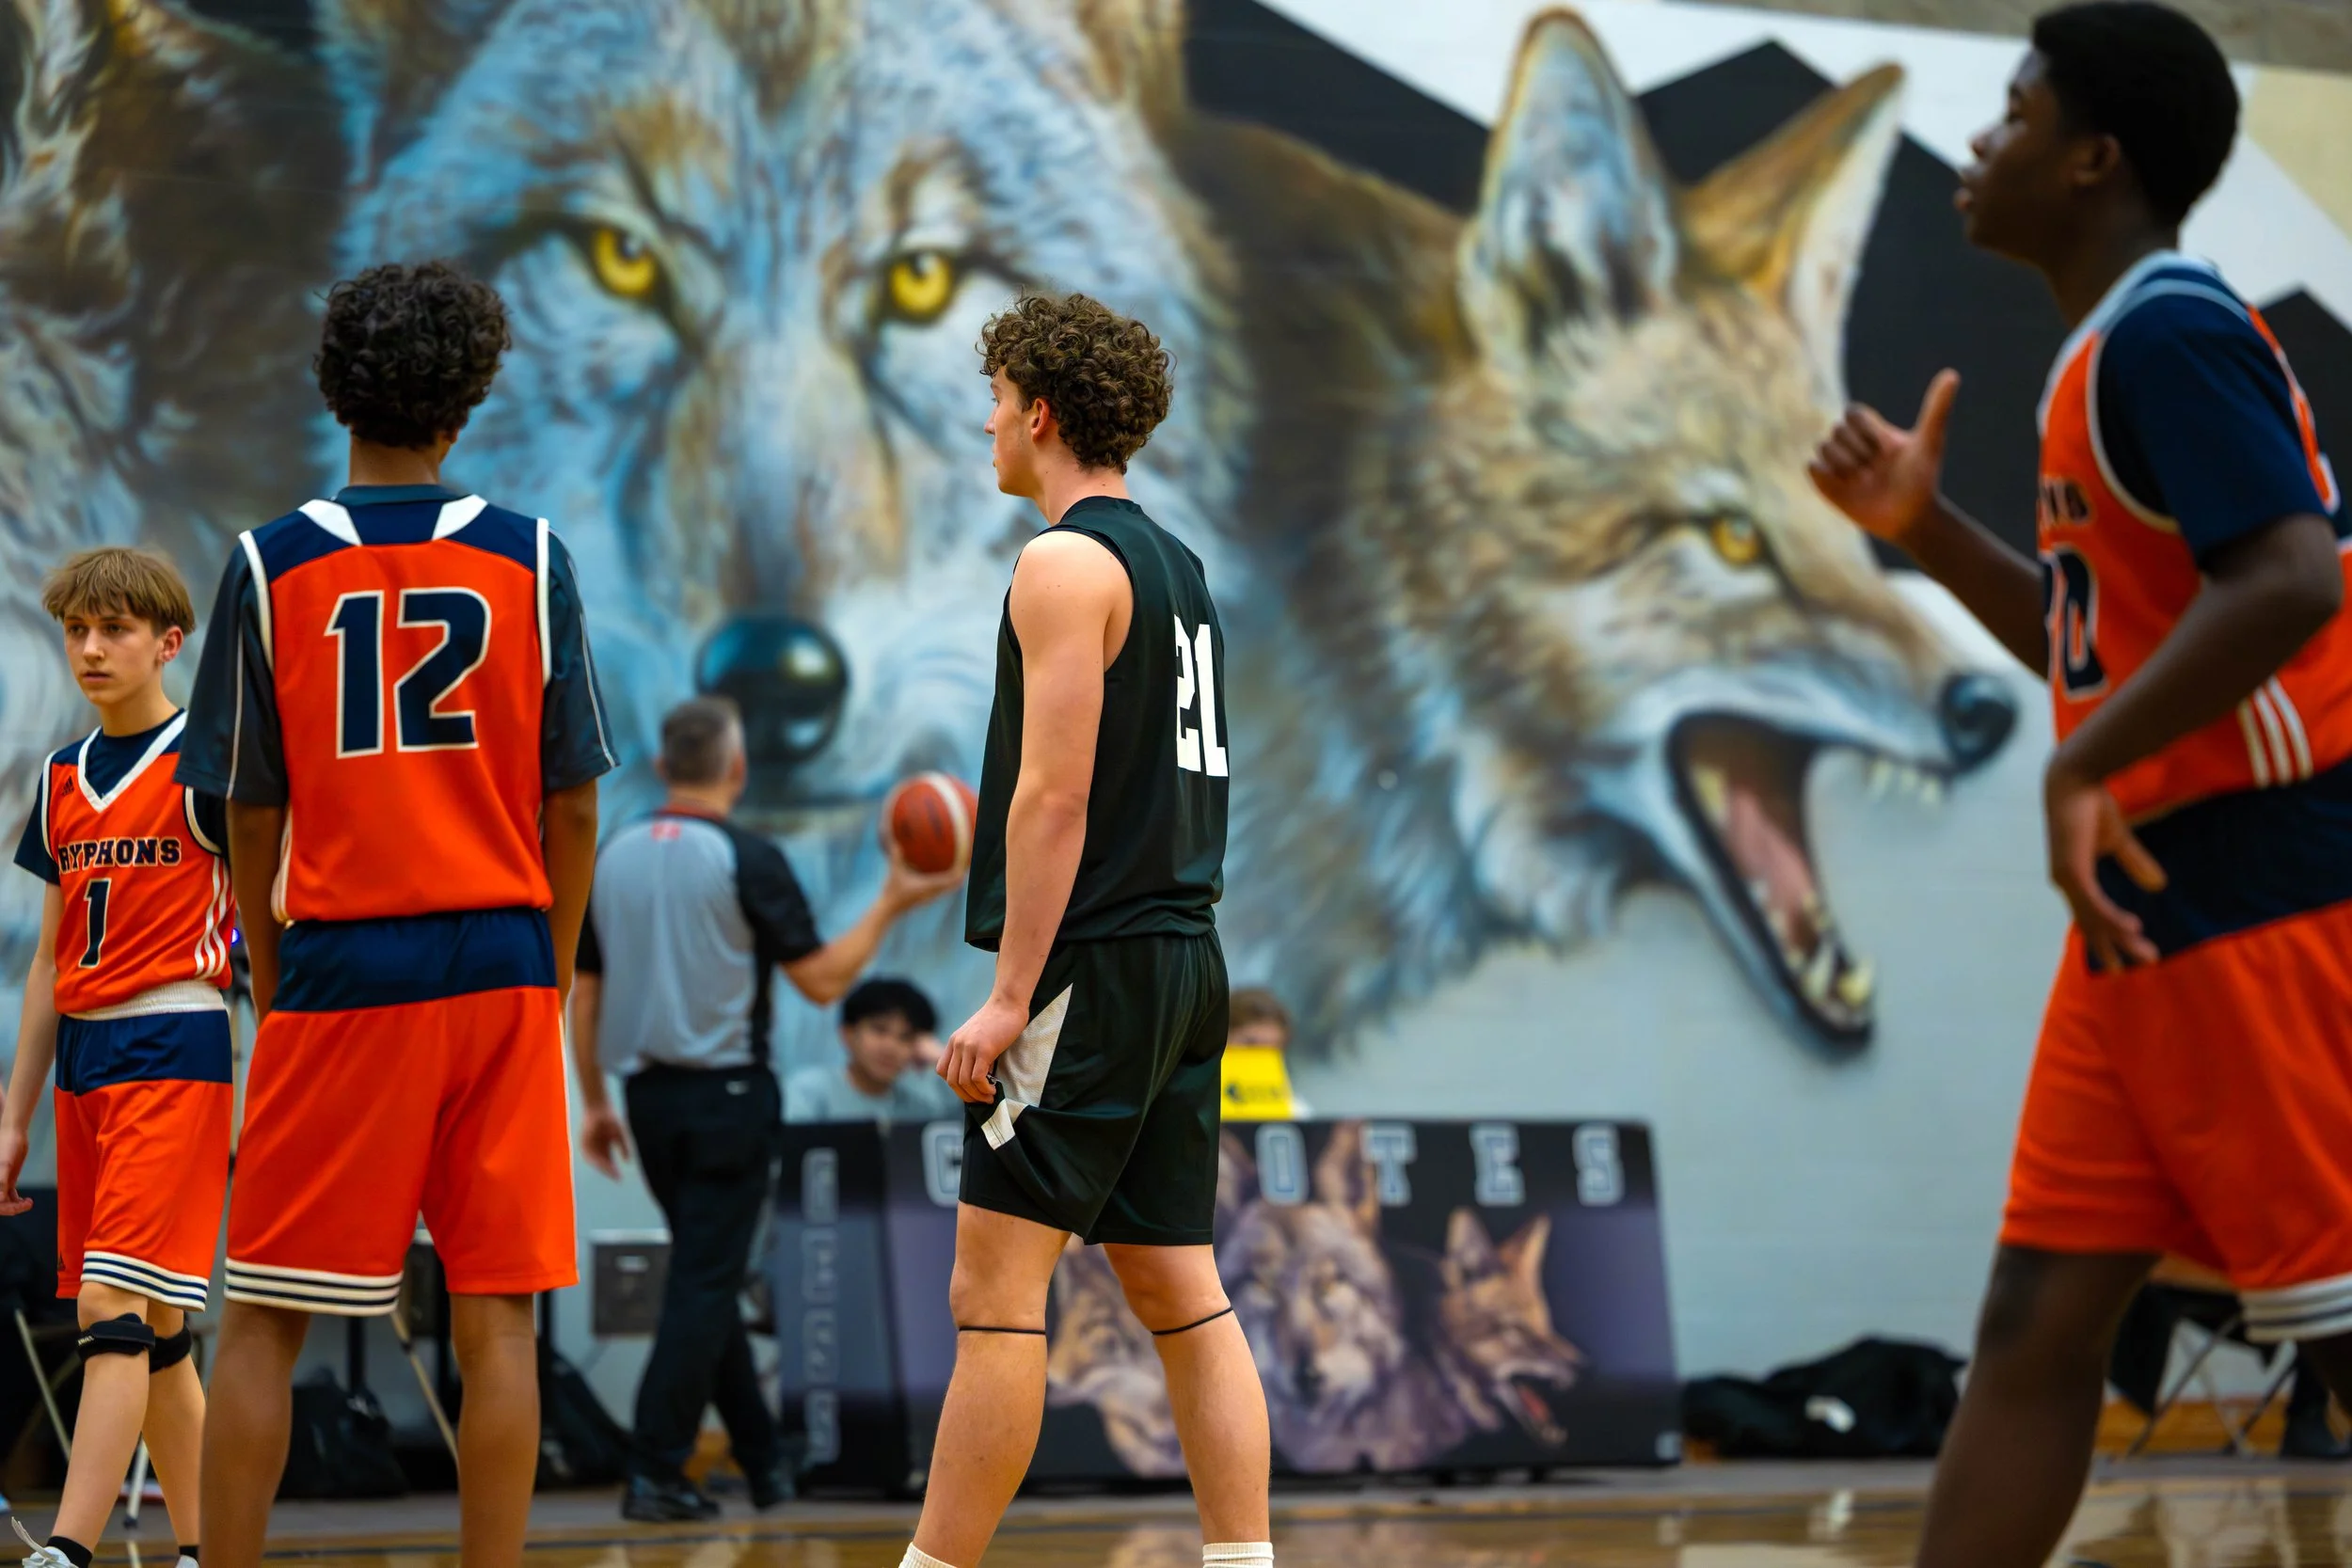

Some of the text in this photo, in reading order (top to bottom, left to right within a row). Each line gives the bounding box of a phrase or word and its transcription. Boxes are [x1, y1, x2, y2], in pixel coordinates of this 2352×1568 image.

[324, 586, 492, 759] 12
[1174, 614, 1229, 777] 21
[58, 836, 182, 875] RYPHONS
[78, 878, 112, 968] 1
[921, 1119, 1625, 1208] COTES
